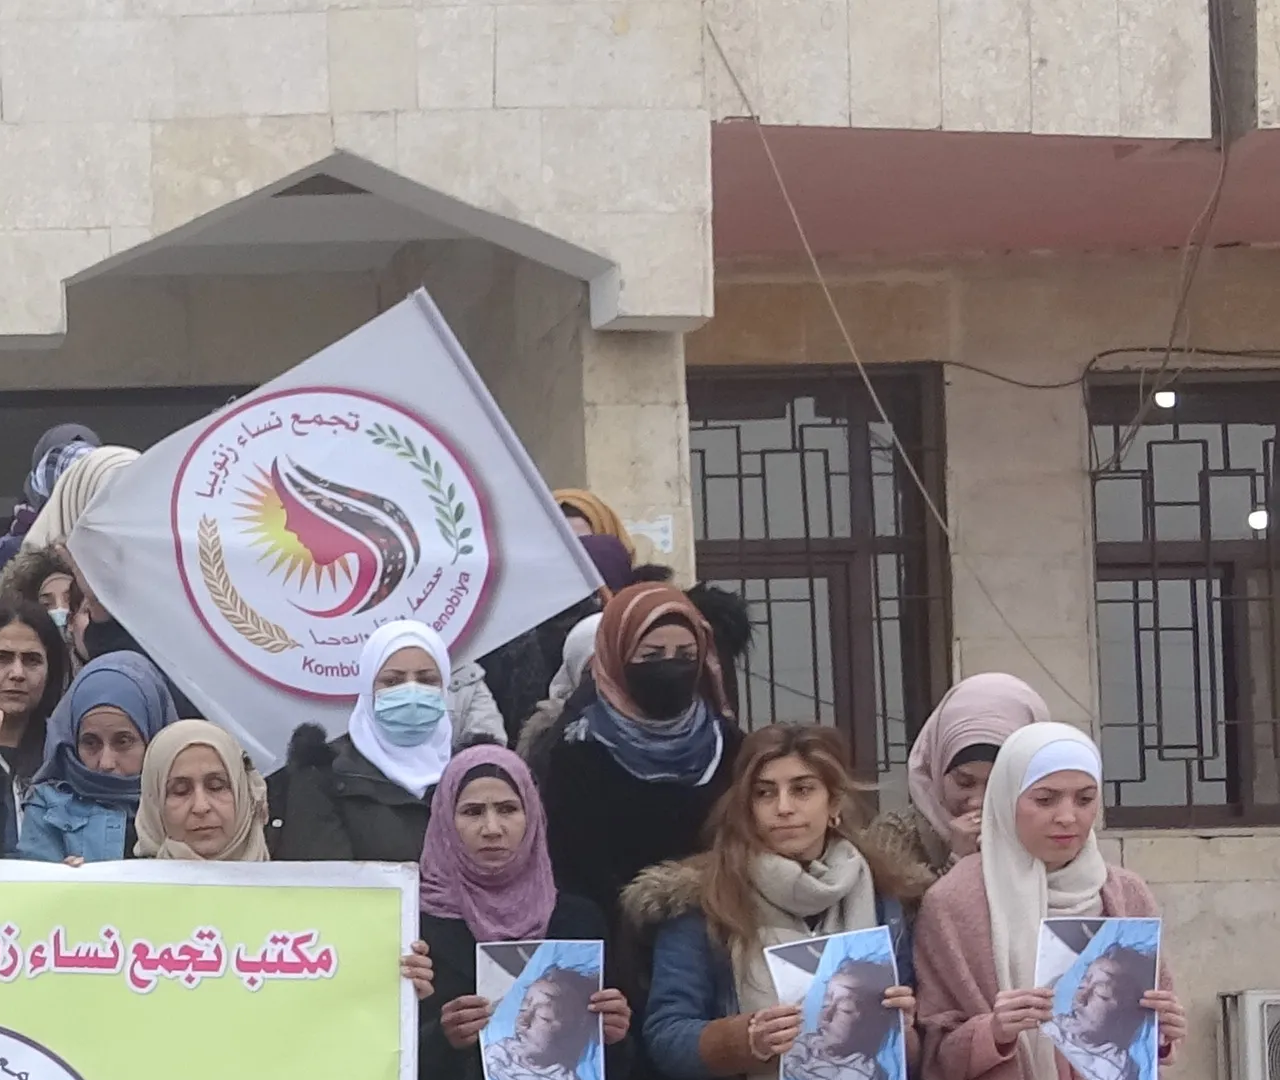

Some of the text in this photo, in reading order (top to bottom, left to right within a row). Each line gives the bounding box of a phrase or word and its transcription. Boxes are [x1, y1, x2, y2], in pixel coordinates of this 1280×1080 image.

[194, 411, 360, 499] تجمع نساء زنوبيا
[302, 655, 360, 678] Kombû
[427, 571, 471, 632] enobiya
[28, 927, 121, 975] نساء
[127, 928, 224, 990] تجمع
[235, 931, 334, 988] مكتب
